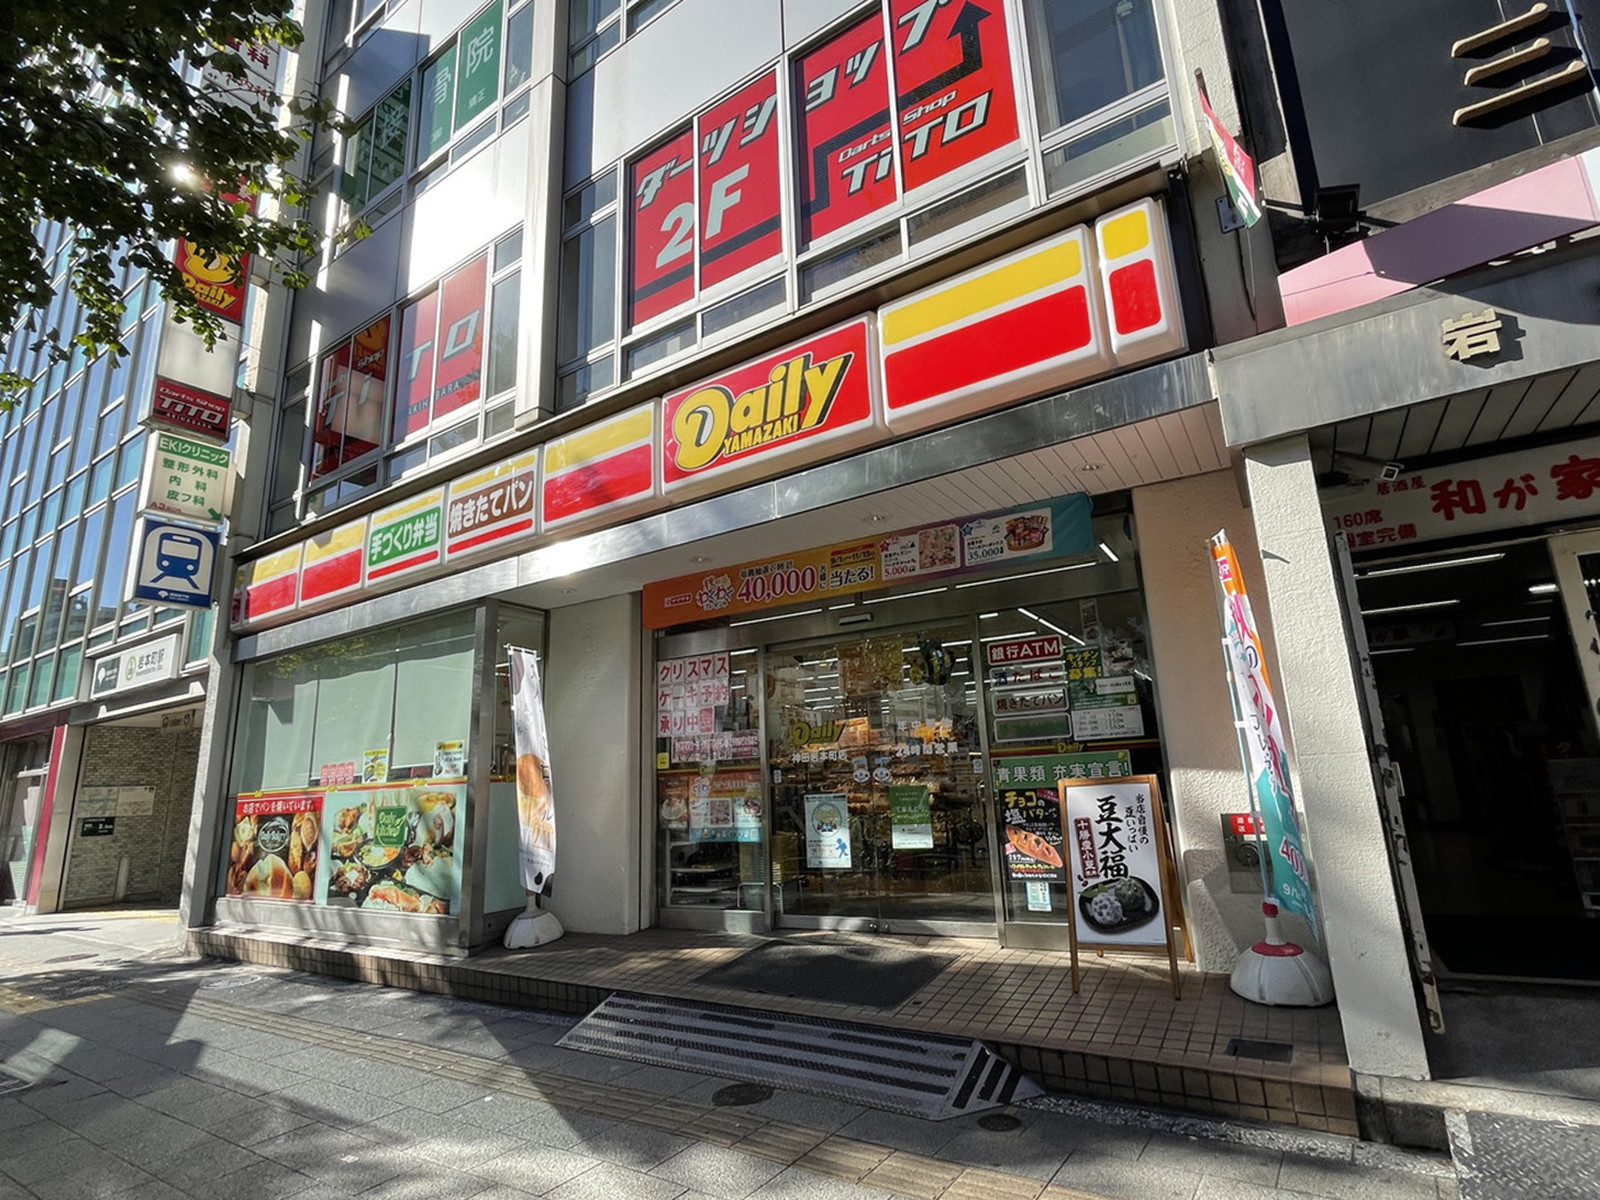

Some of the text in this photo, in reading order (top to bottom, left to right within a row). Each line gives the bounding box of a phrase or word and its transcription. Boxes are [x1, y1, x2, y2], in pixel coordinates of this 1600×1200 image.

[655, 163, 750, 269] 2F
[1441, 307, 1503, 361] 岩
[408, 381, 460, 416] AKIHBARA
[673, 351, 854, 469] Daily
[723, 413, 800, 456] YAMAZAKI
[160, 437, 228, 464] EKIクリニック
[162, 457, 219, 480] 整形外科
[166, 489, 206, 507] 皮フ科
[1375, 474, 1427, 497] 居酒屋
[1430, 454, 1600, 521] 和が家
[449, 478, 534, 534] 焼きたてパン
[1333, 508, 1384, 530] 160席
[372, 511, 439, 563] 手づくり弁当
[737, 565, 817, 603] 40,000
[991, 639, 1059, 662] 銀行ATM
[1066, 650, 1099, 662] キッチン
[660, 656, 728, 681] クリスマス
[1012, 667, 1061, 684] たばこ
[659, 684, 728, 707] ケーキ予約
[996, 692, 1064, 712] 焼きたてパン
[660, 713, 699, 733] 承り中
[791, 720, 845, 747] Daily
[996, 761, 1129, 783] 青果類 充実宣言!
[1004, 790, 1046, 808] チョコの
[1094, 794, 1128, 879] 豆大福
